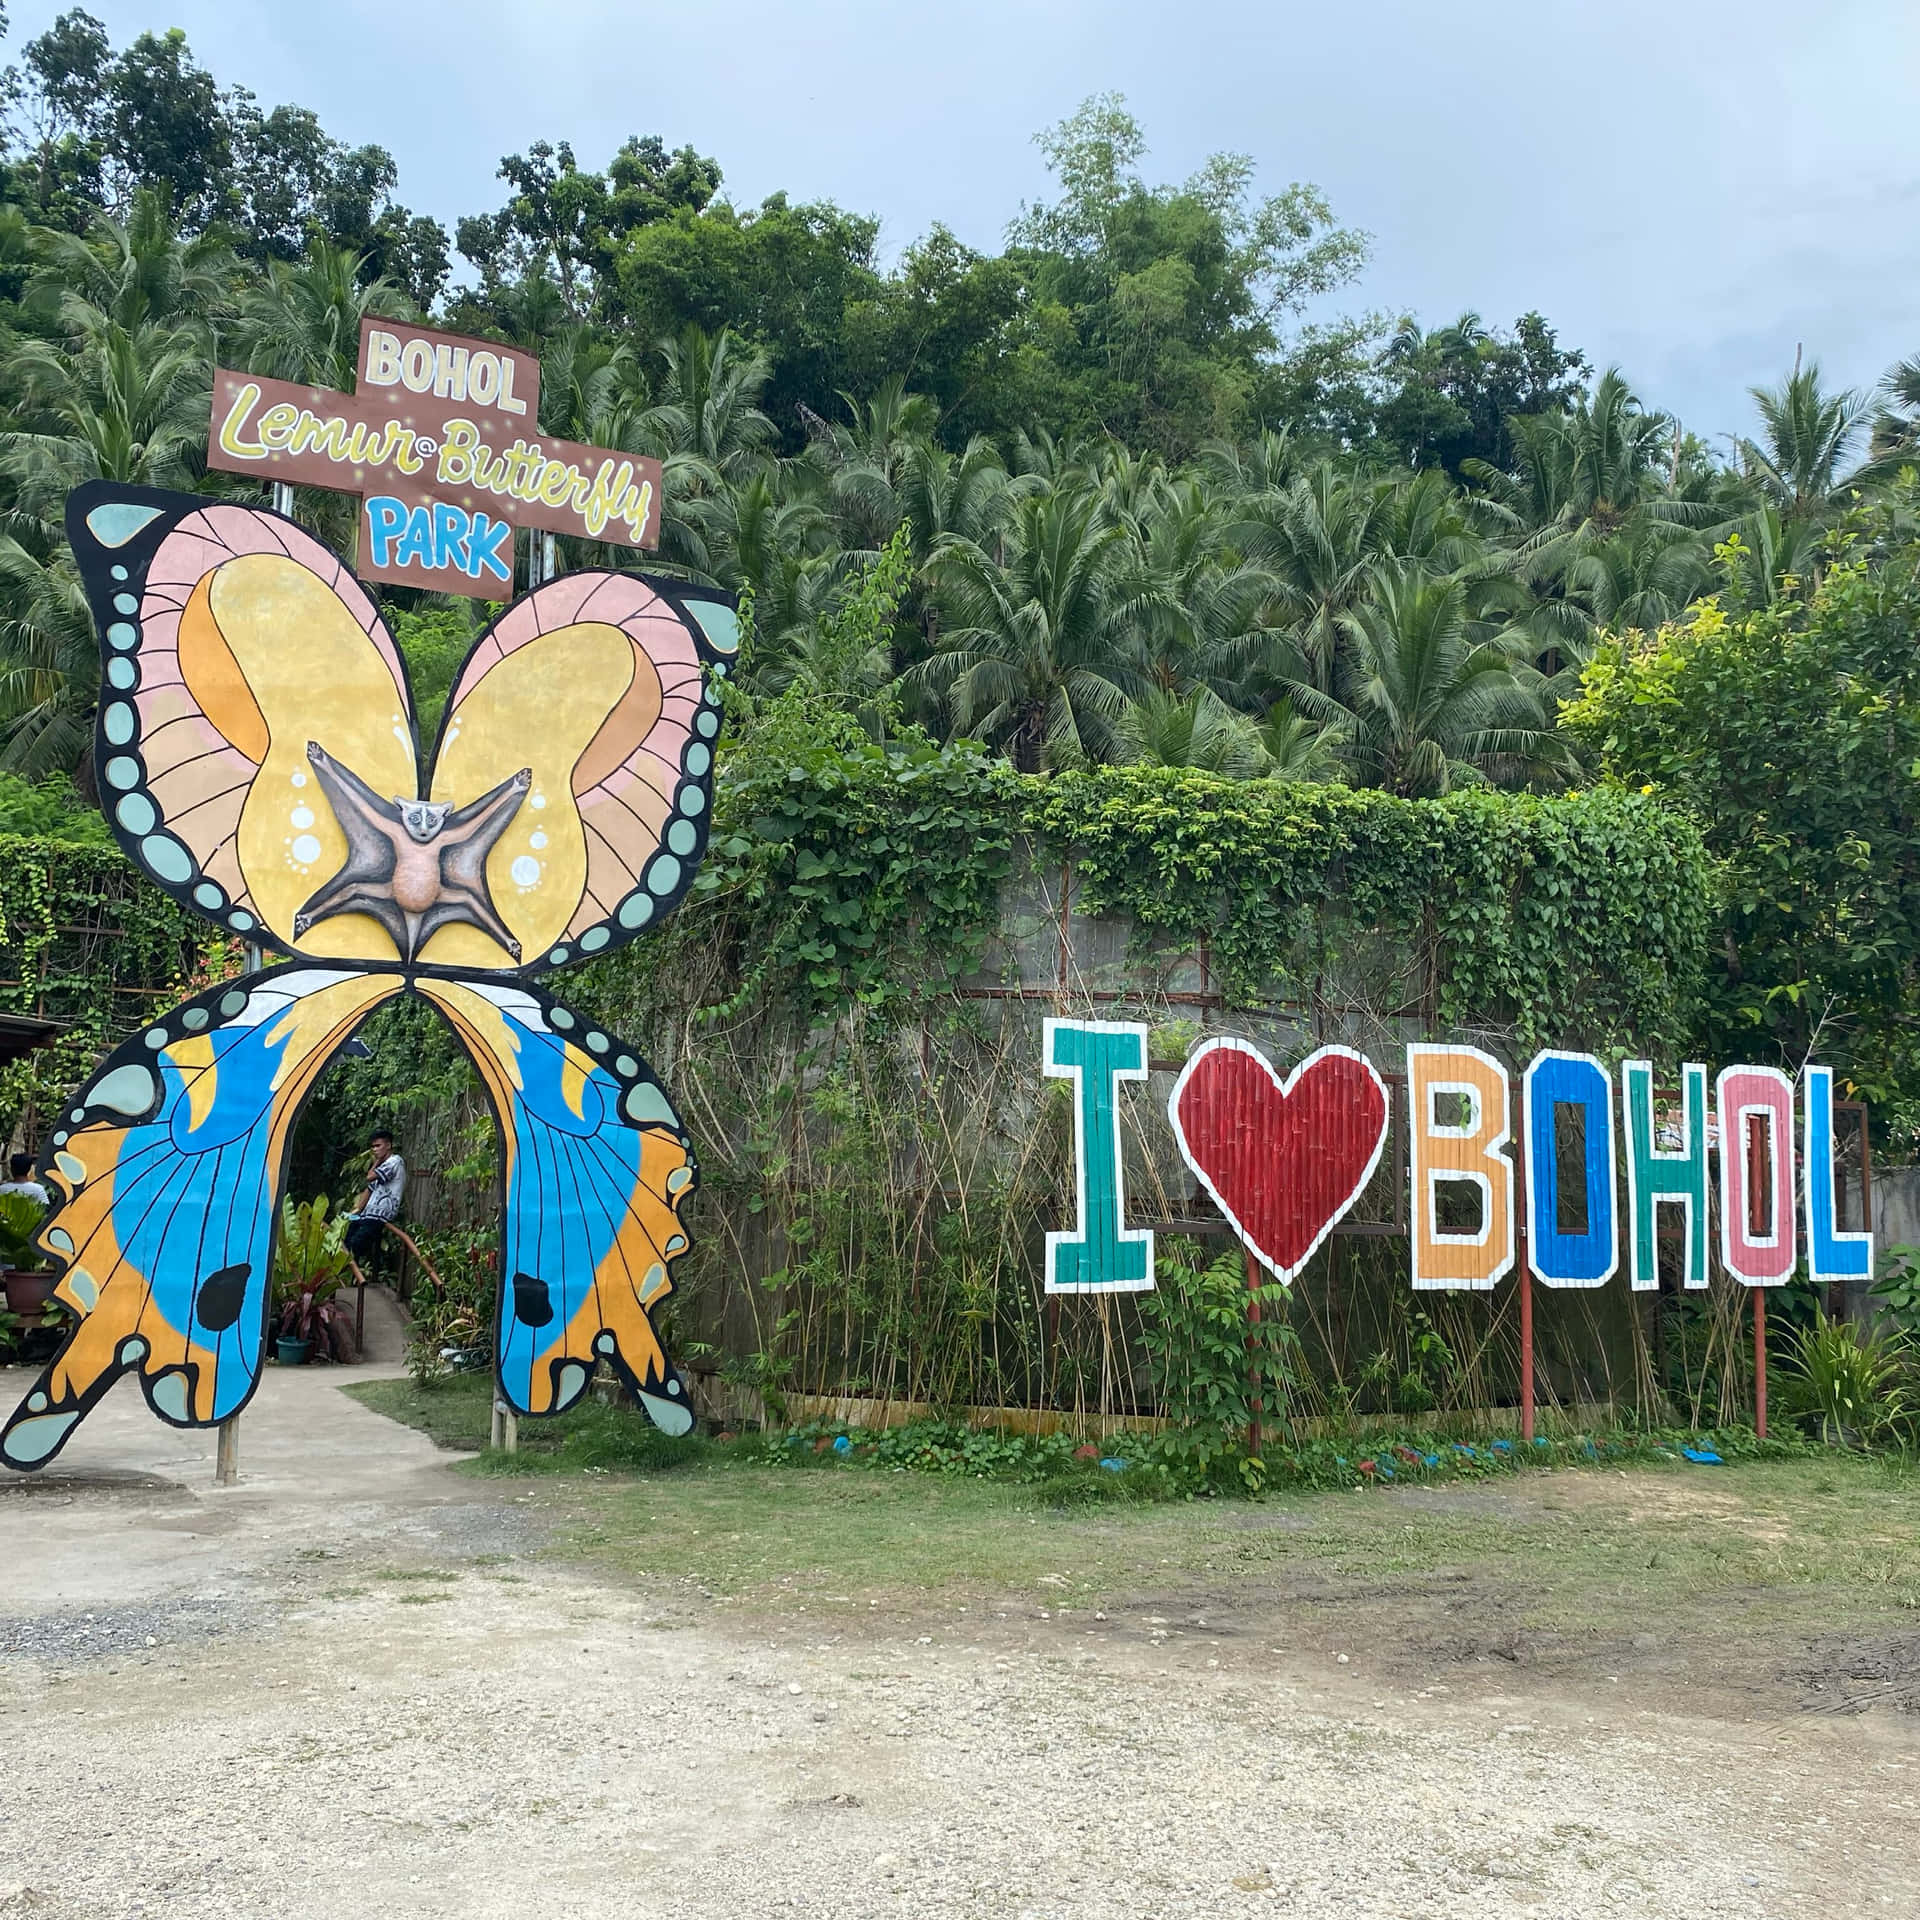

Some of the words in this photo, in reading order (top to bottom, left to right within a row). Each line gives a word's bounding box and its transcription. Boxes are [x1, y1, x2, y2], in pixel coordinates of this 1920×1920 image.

[366, 330, 527, 415] BOHOL
[219, 383, 424, 475] Lemur
[437, 418, 652, 543] Butterfly
[365, 496, 512, 582] PARK
[1042, 1017, 1156, 1294] I
[1407, 1042, 1875, 1291] BOHOL
